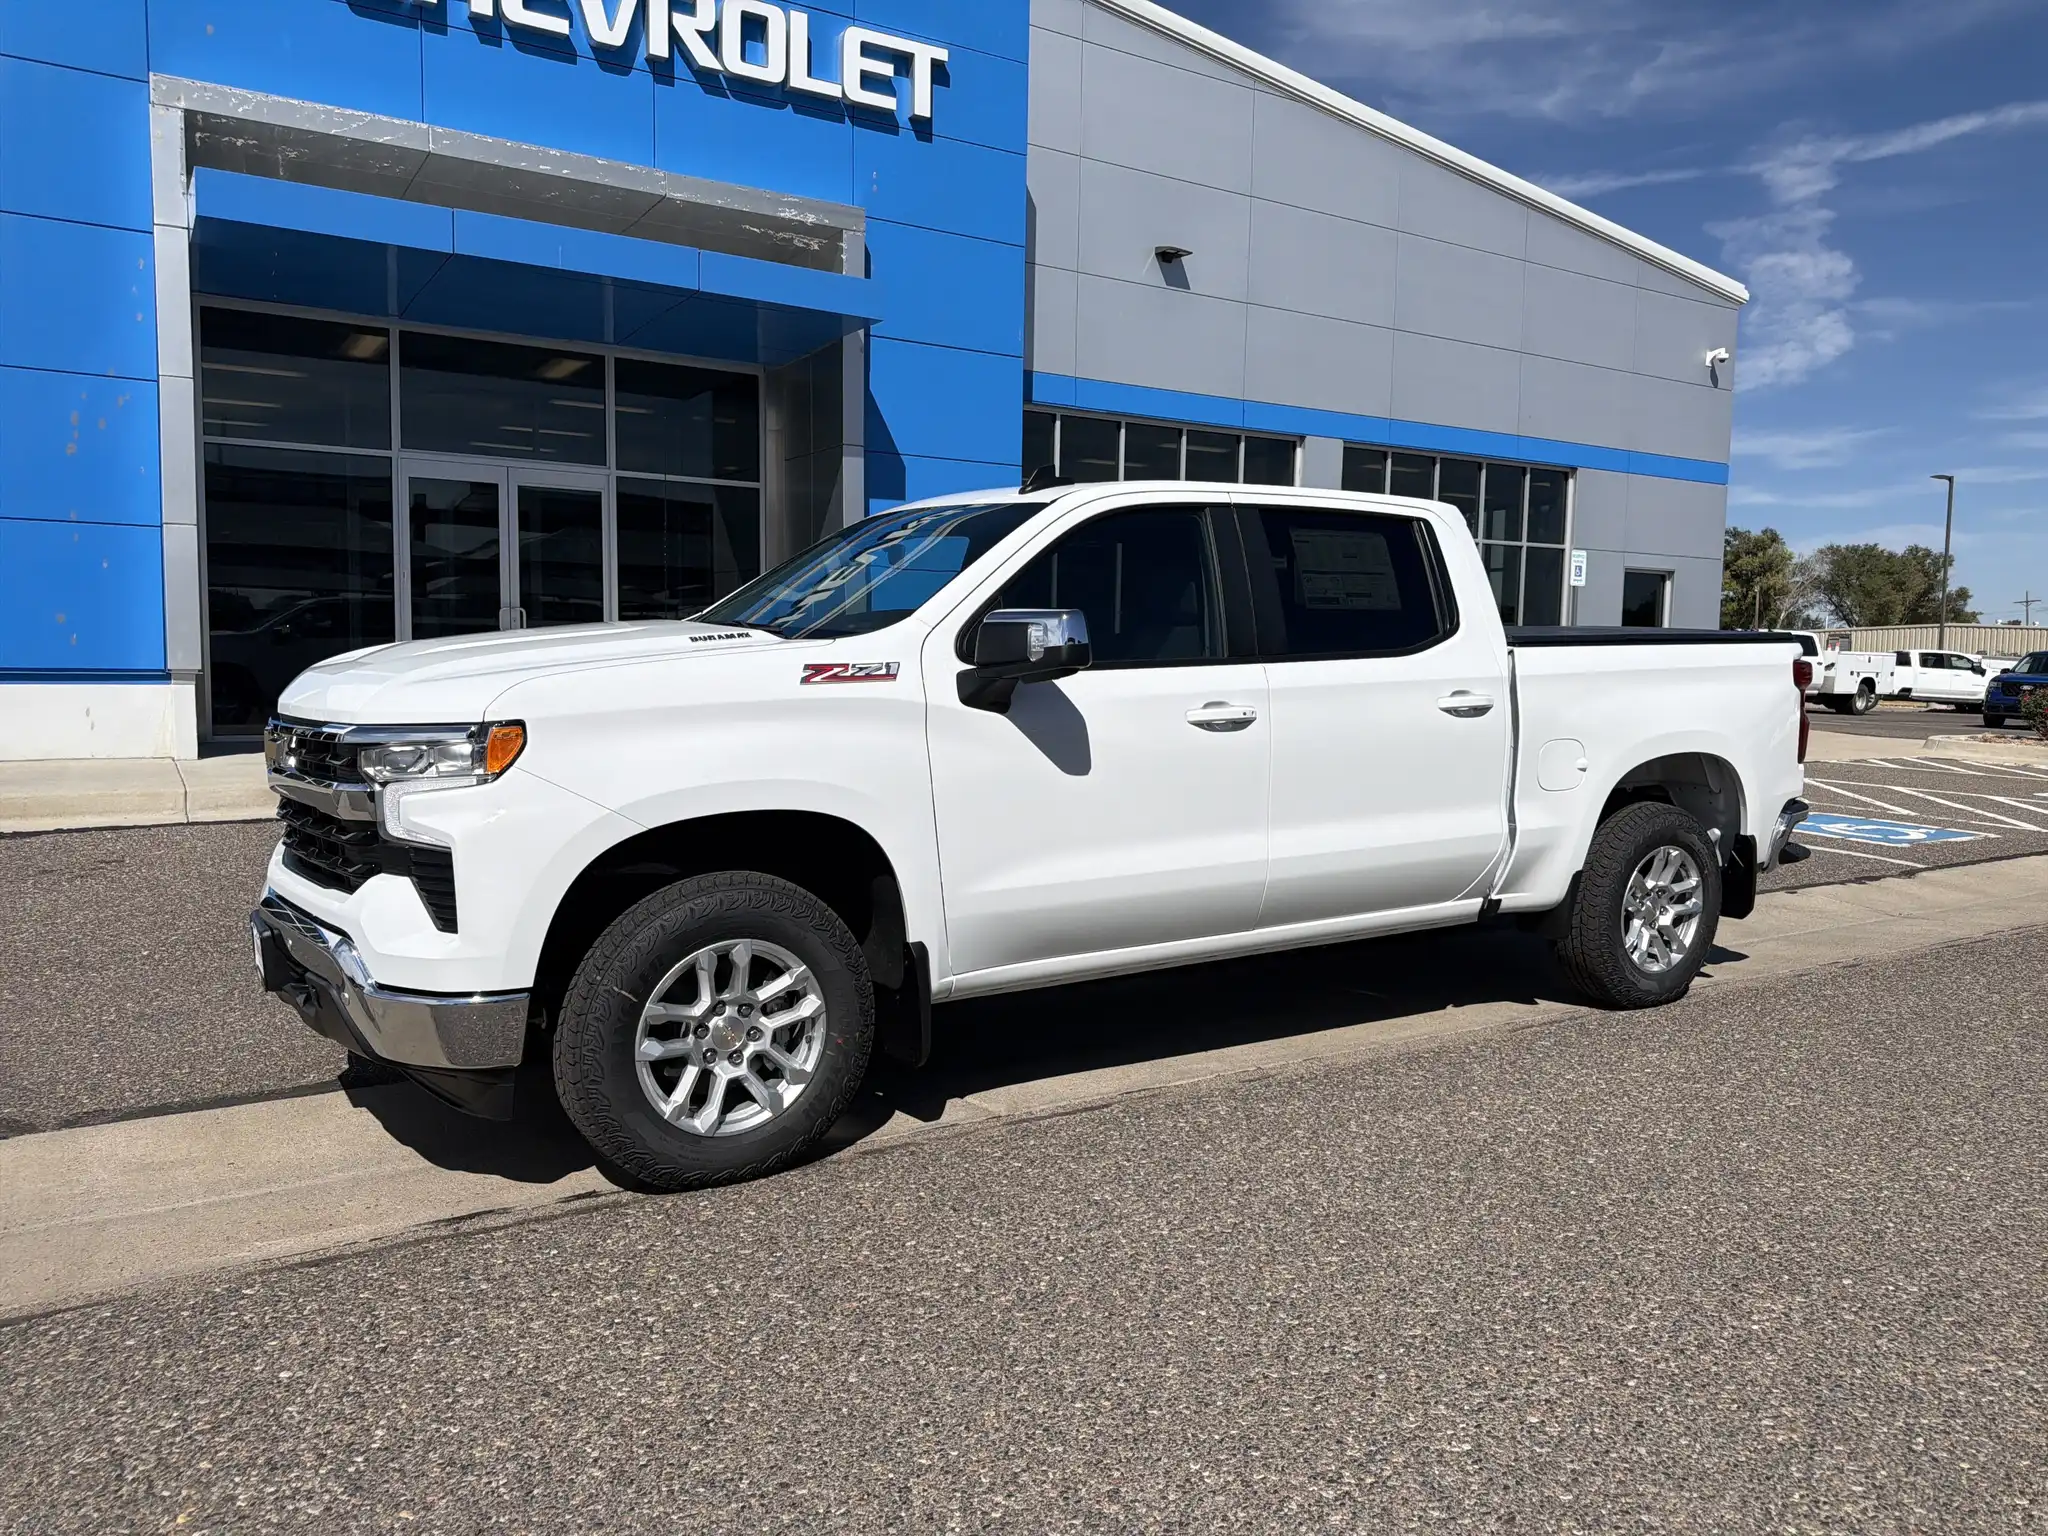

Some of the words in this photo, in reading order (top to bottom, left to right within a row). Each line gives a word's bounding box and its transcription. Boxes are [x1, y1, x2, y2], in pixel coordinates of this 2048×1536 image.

[411, 0, 949, 118] VROLET
[688, 631, 753, 643] DURAMAX
[799, 661, 900, 685] Z71
